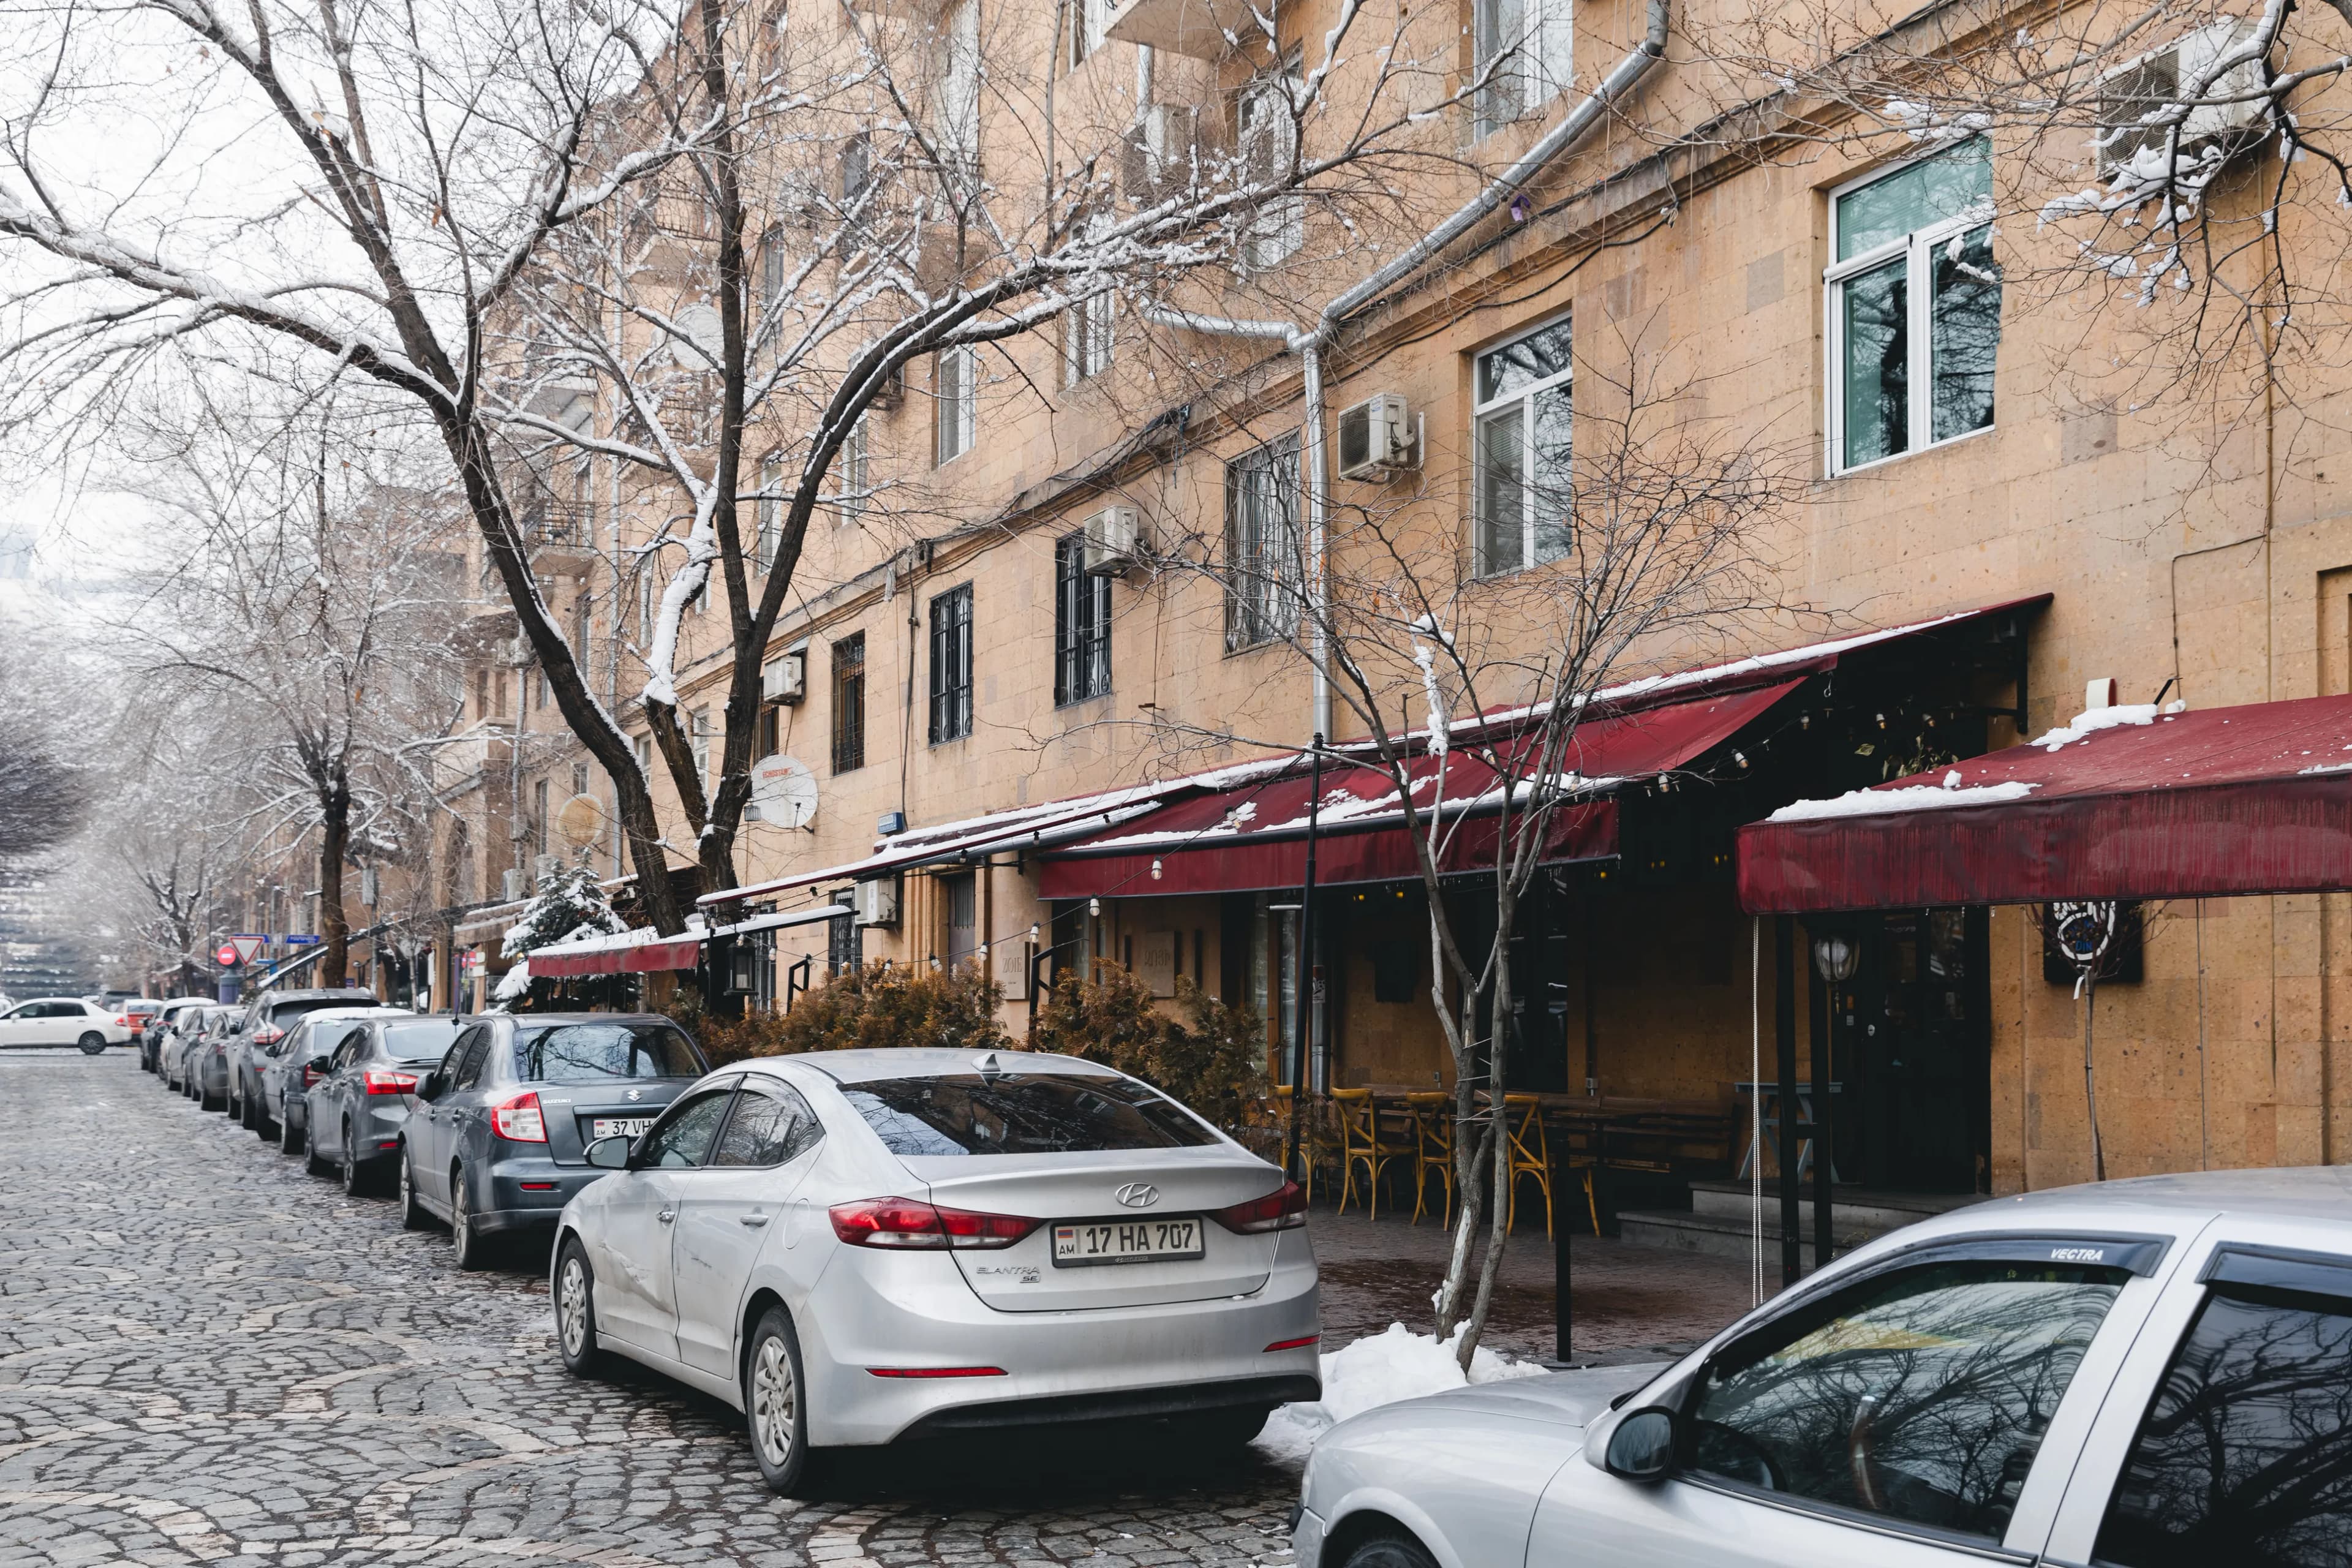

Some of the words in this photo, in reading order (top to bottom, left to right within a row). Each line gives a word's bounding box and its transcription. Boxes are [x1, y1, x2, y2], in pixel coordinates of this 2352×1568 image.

[1003, 956, 1023, 973] ZOIE
[612, 1121, 628, 1134] 37
[1086, 1226, 1112, 1254] 17
[1119, 1225, 1150, 1252] HA
[1156, 1223, 1194, 1250] 707
[1058, 1244, 1074, 1255] AM
[2050, 1249, 2104, 1261] VECTRA
[976, 1266, 1041, 1275] ELANTRA
